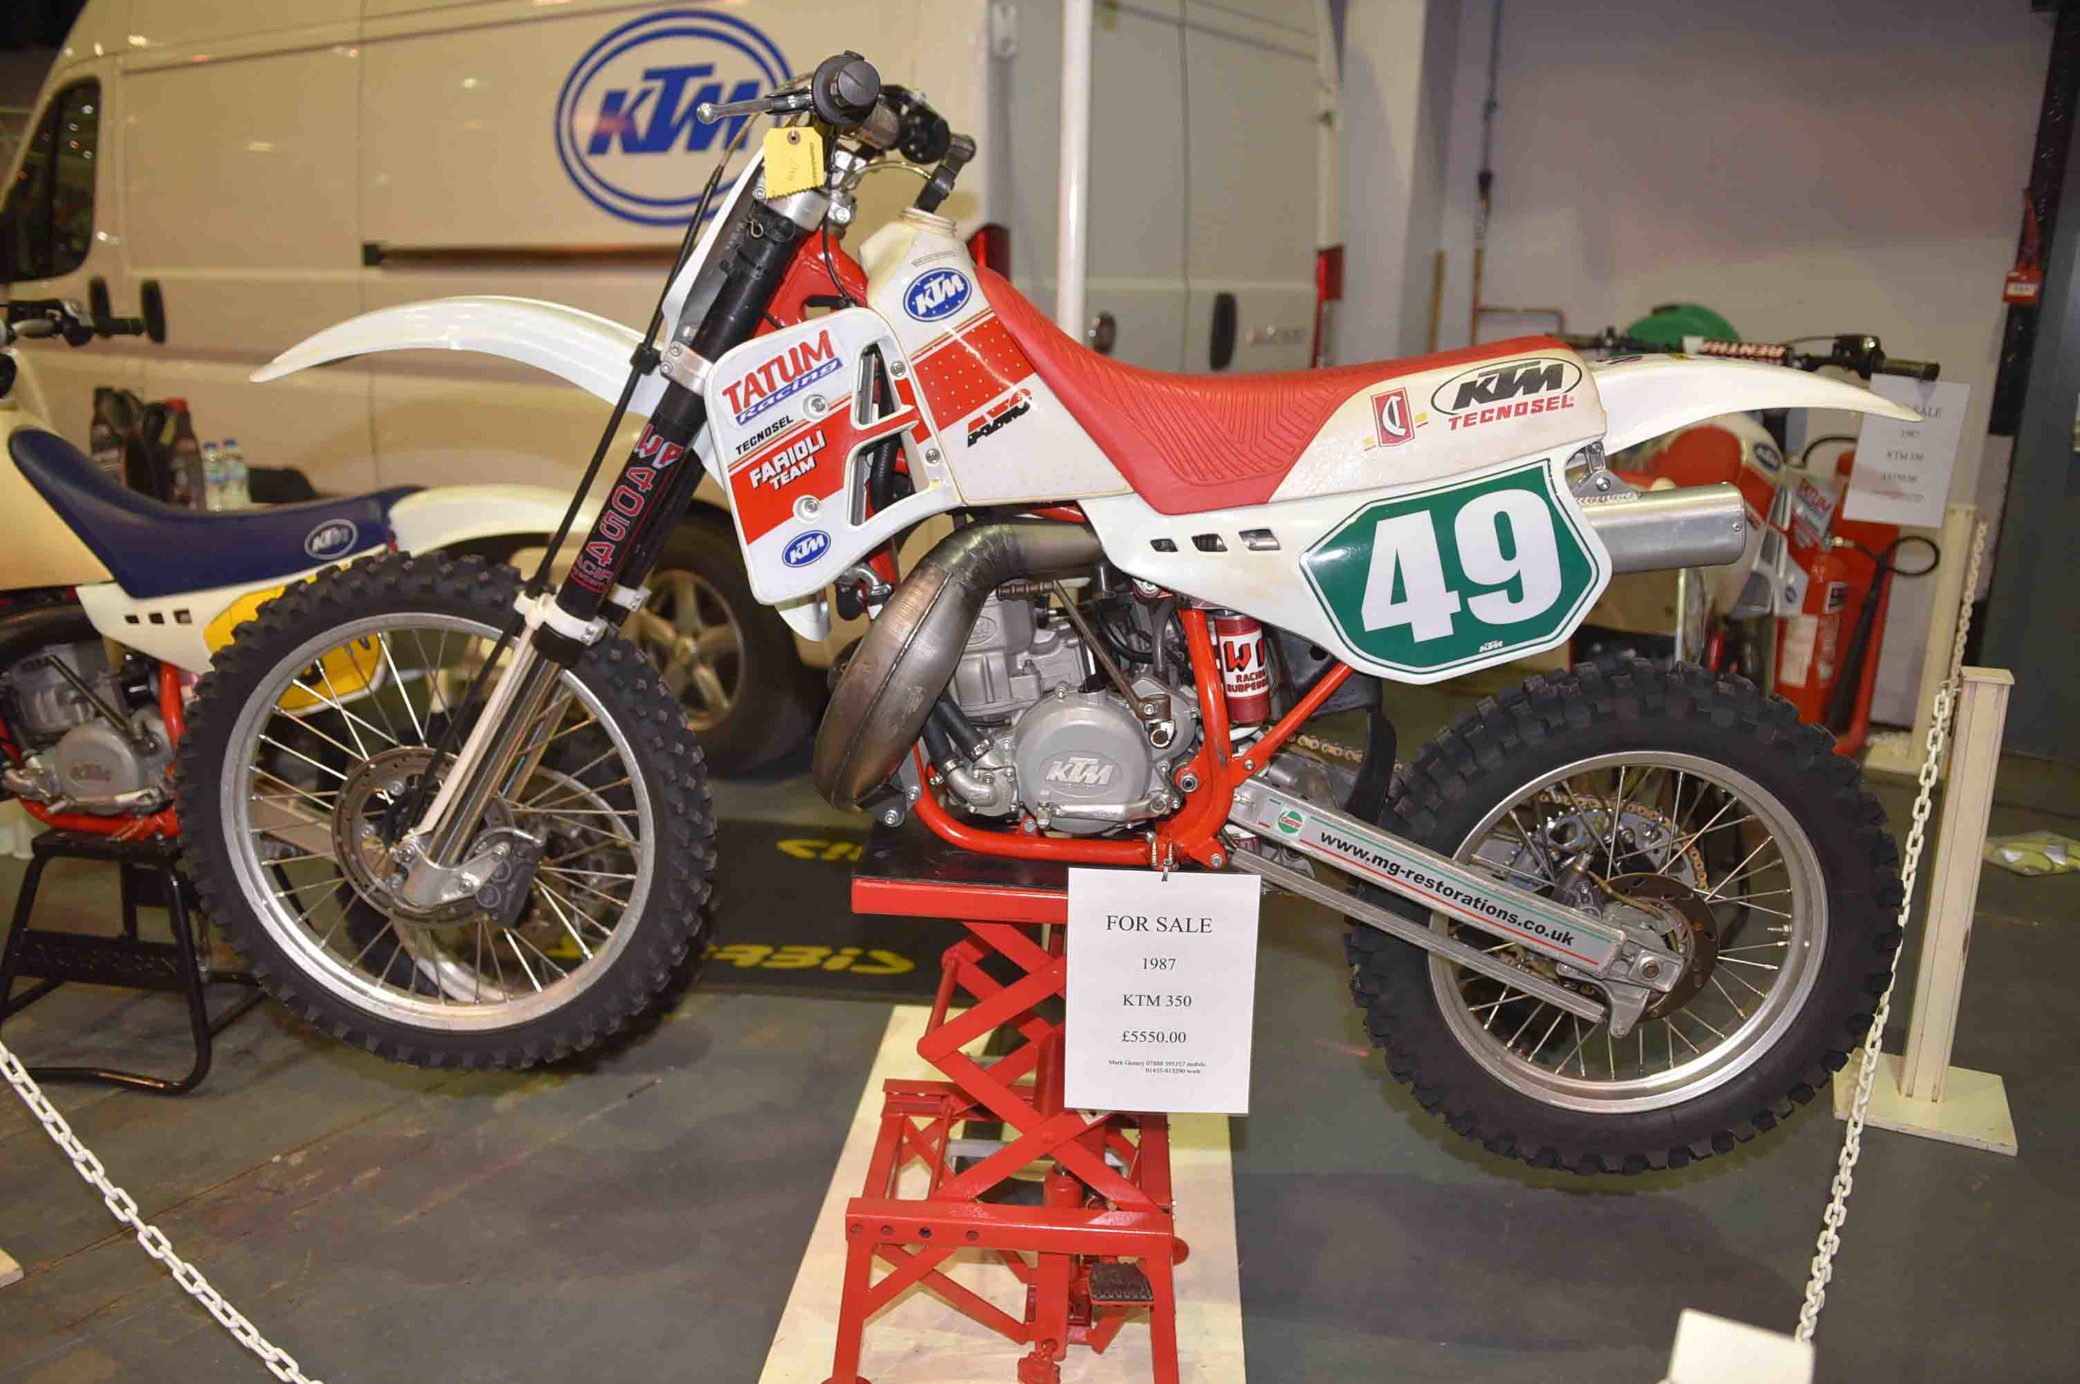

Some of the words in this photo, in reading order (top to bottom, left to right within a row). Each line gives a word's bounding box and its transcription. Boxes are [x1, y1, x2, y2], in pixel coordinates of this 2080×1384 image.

[587, 64, 761, 156] KTM
[916, 272, 966, 315] KTM
[722, 330, 834, 414] TATUM
[1452, 361, 1564, 411] KTM
[738, 359, 841, 423] Racing
[1449, 395, 1574, 431] TECNOSEL
[635, 423, 684, 469] WP
[735, 416, 794, 455] TECNOSEL
[749, 430, 827, 489] FARIOLI
[769, 456, 817, 490] TEAM
[312, 527, 351, 552] KTM
[788, 535, 826, 563] KTM
[1361, 489, 1563, 643] 49
[1236, 671, 1266, 683] RACIN
[1046, 757, 1113, 786] KTM
[1320, 831, 1575, 947] www.mg-restorations.co.uk
[1106, 915, 1149, 931] FOR
[1156, 917, 1213, 933] SALE
[1142, 957, 1176, 970] 1987
[1123, 994, 1161, 1007] KTM
[1165, 995, 1192, 1007] 350
[1121, 1031, 1187, 1043] £5550.00
